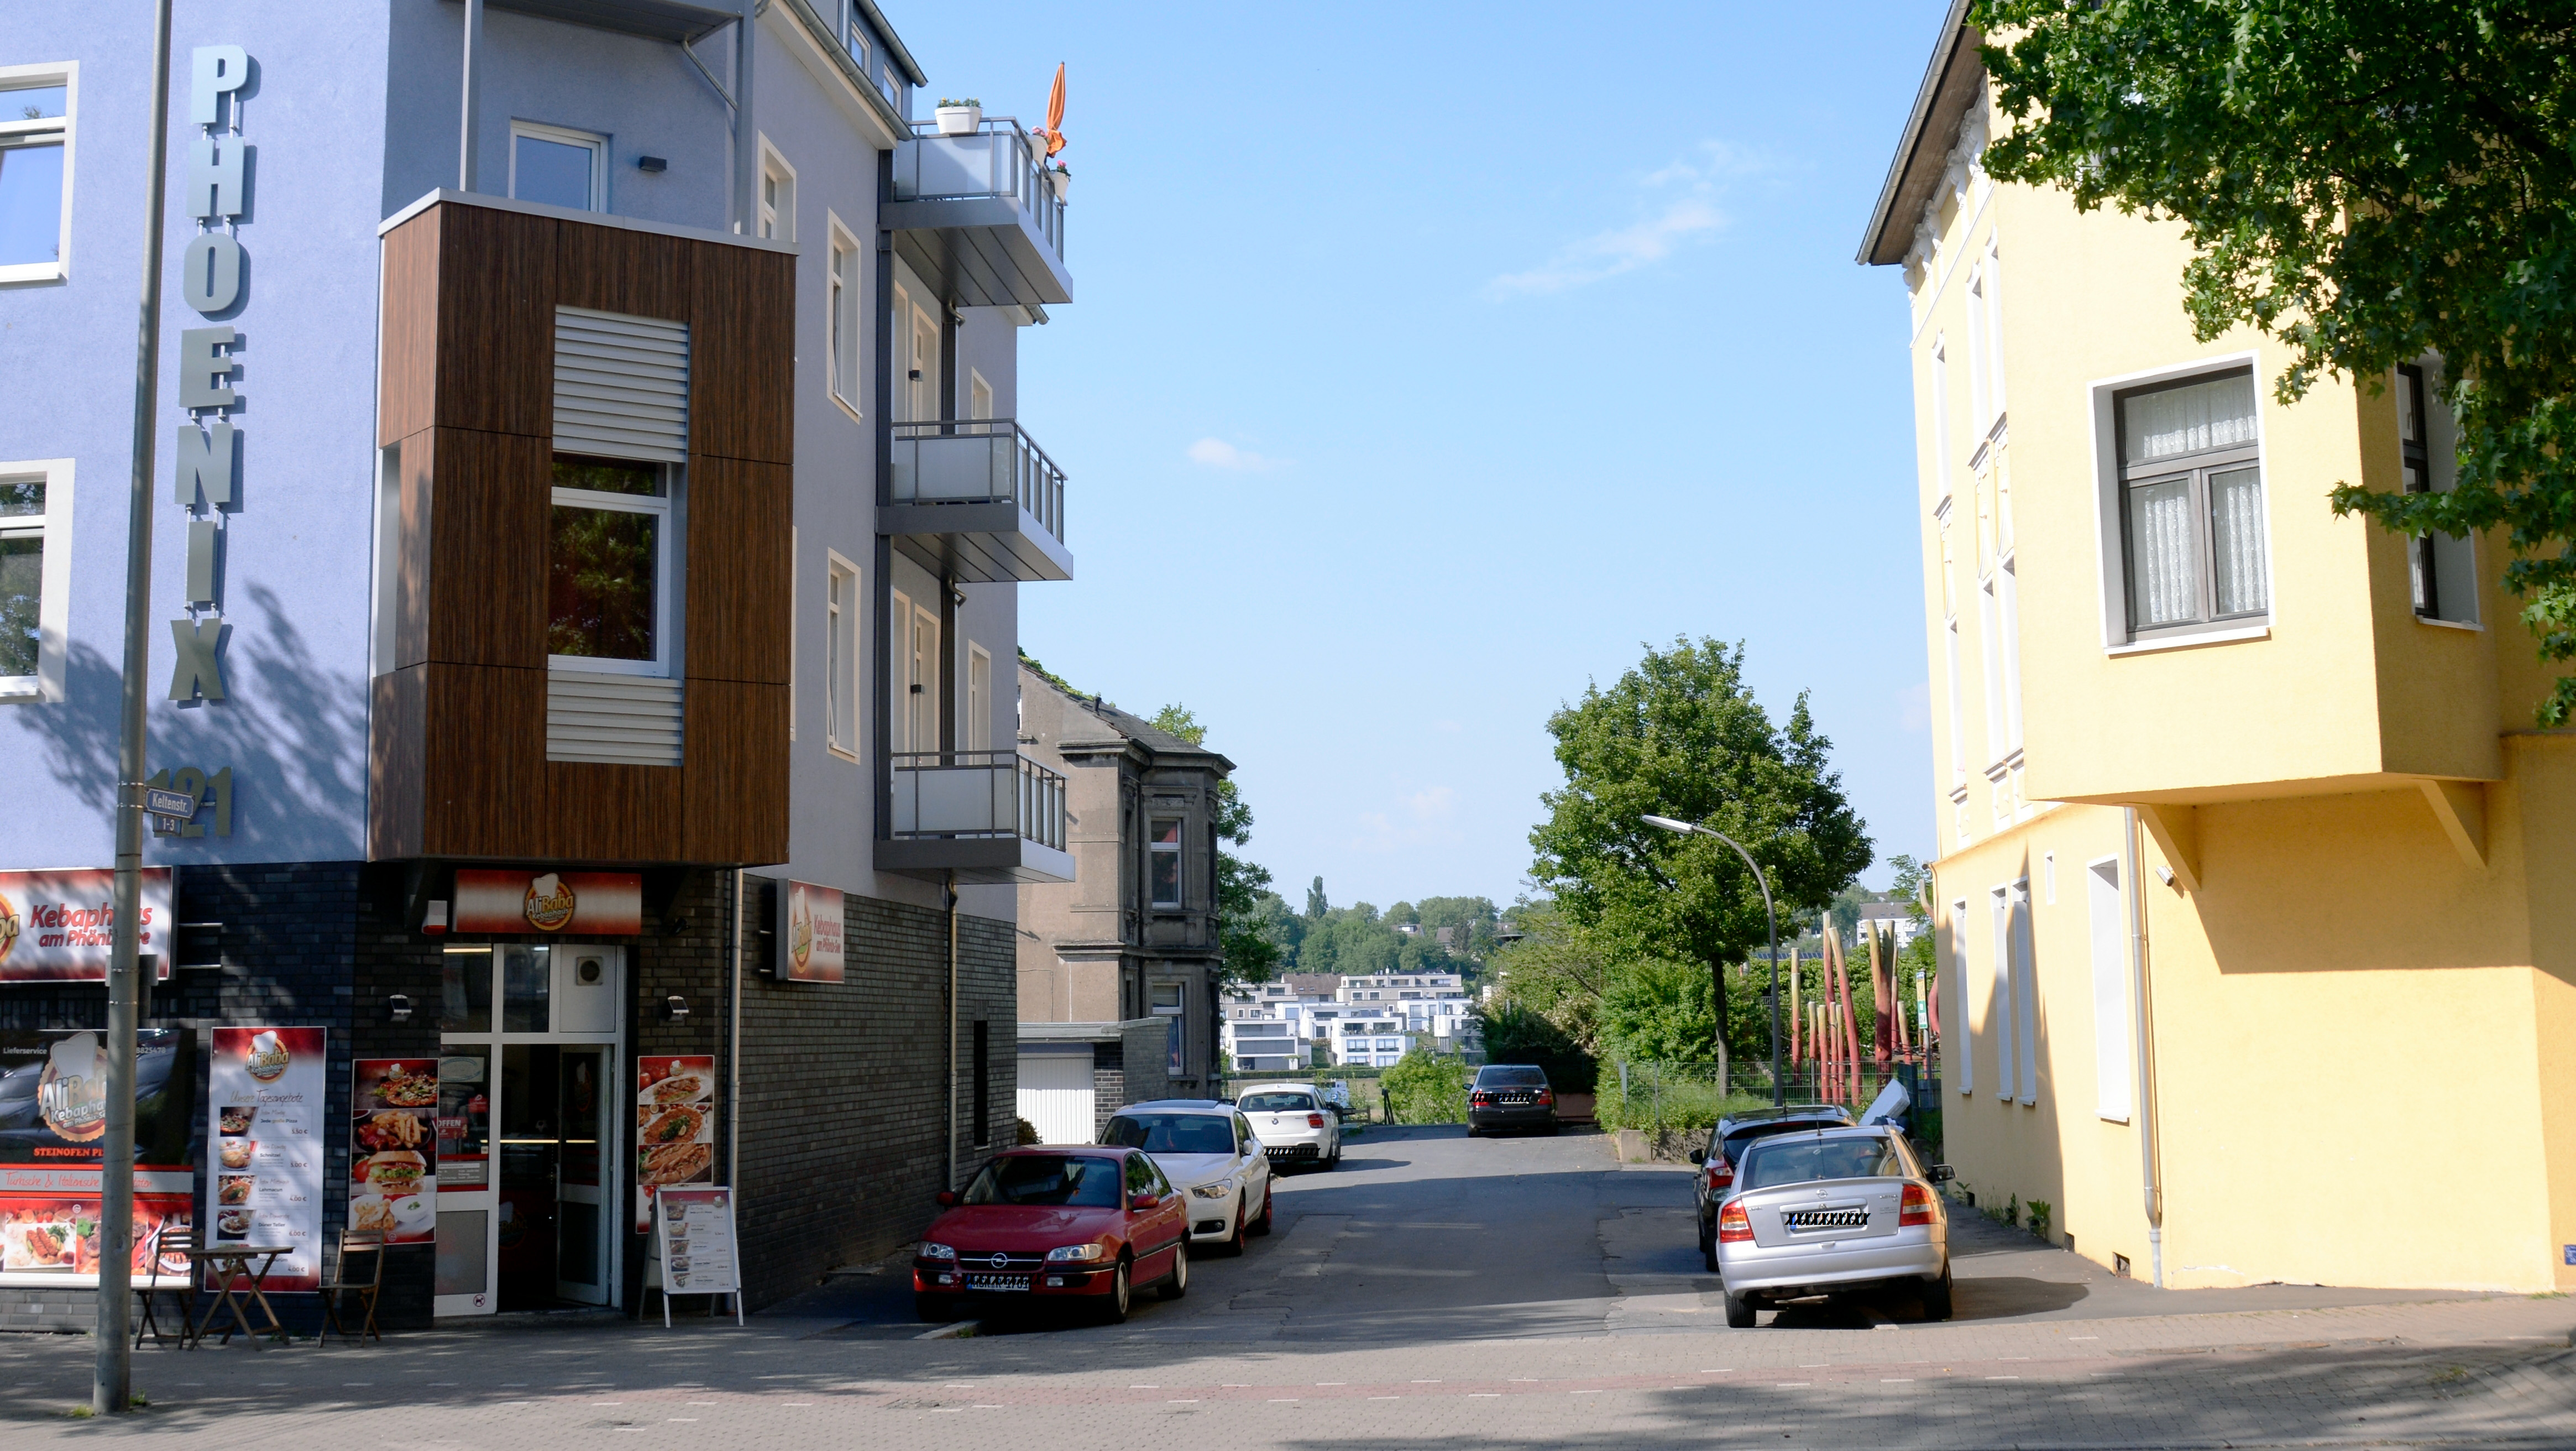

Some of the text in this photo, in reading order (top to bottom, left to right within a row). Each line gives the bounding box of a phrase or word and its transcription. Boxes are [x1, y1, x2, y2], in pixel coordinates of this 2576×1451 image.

[168, 45, 248, 701] PHOENIX
[152, 792, 188, 813] Keltenstr.
[163, 818, 175, 831] 1-3
[526, 894, 574, 916] AliBaba
[30, 902, 153, 933] Kebaphs
[814, 914, 841, 938] Kebaphaus
[39, 933, 64, 947] am
[245, 1049, 289, 1071] AliBaba
[230, 1089, 303, 1106] Unsere Tagesangebote
[62, 1120, 74, 1128] am
[33, 1148, 90, 1156] STEINOFEN
